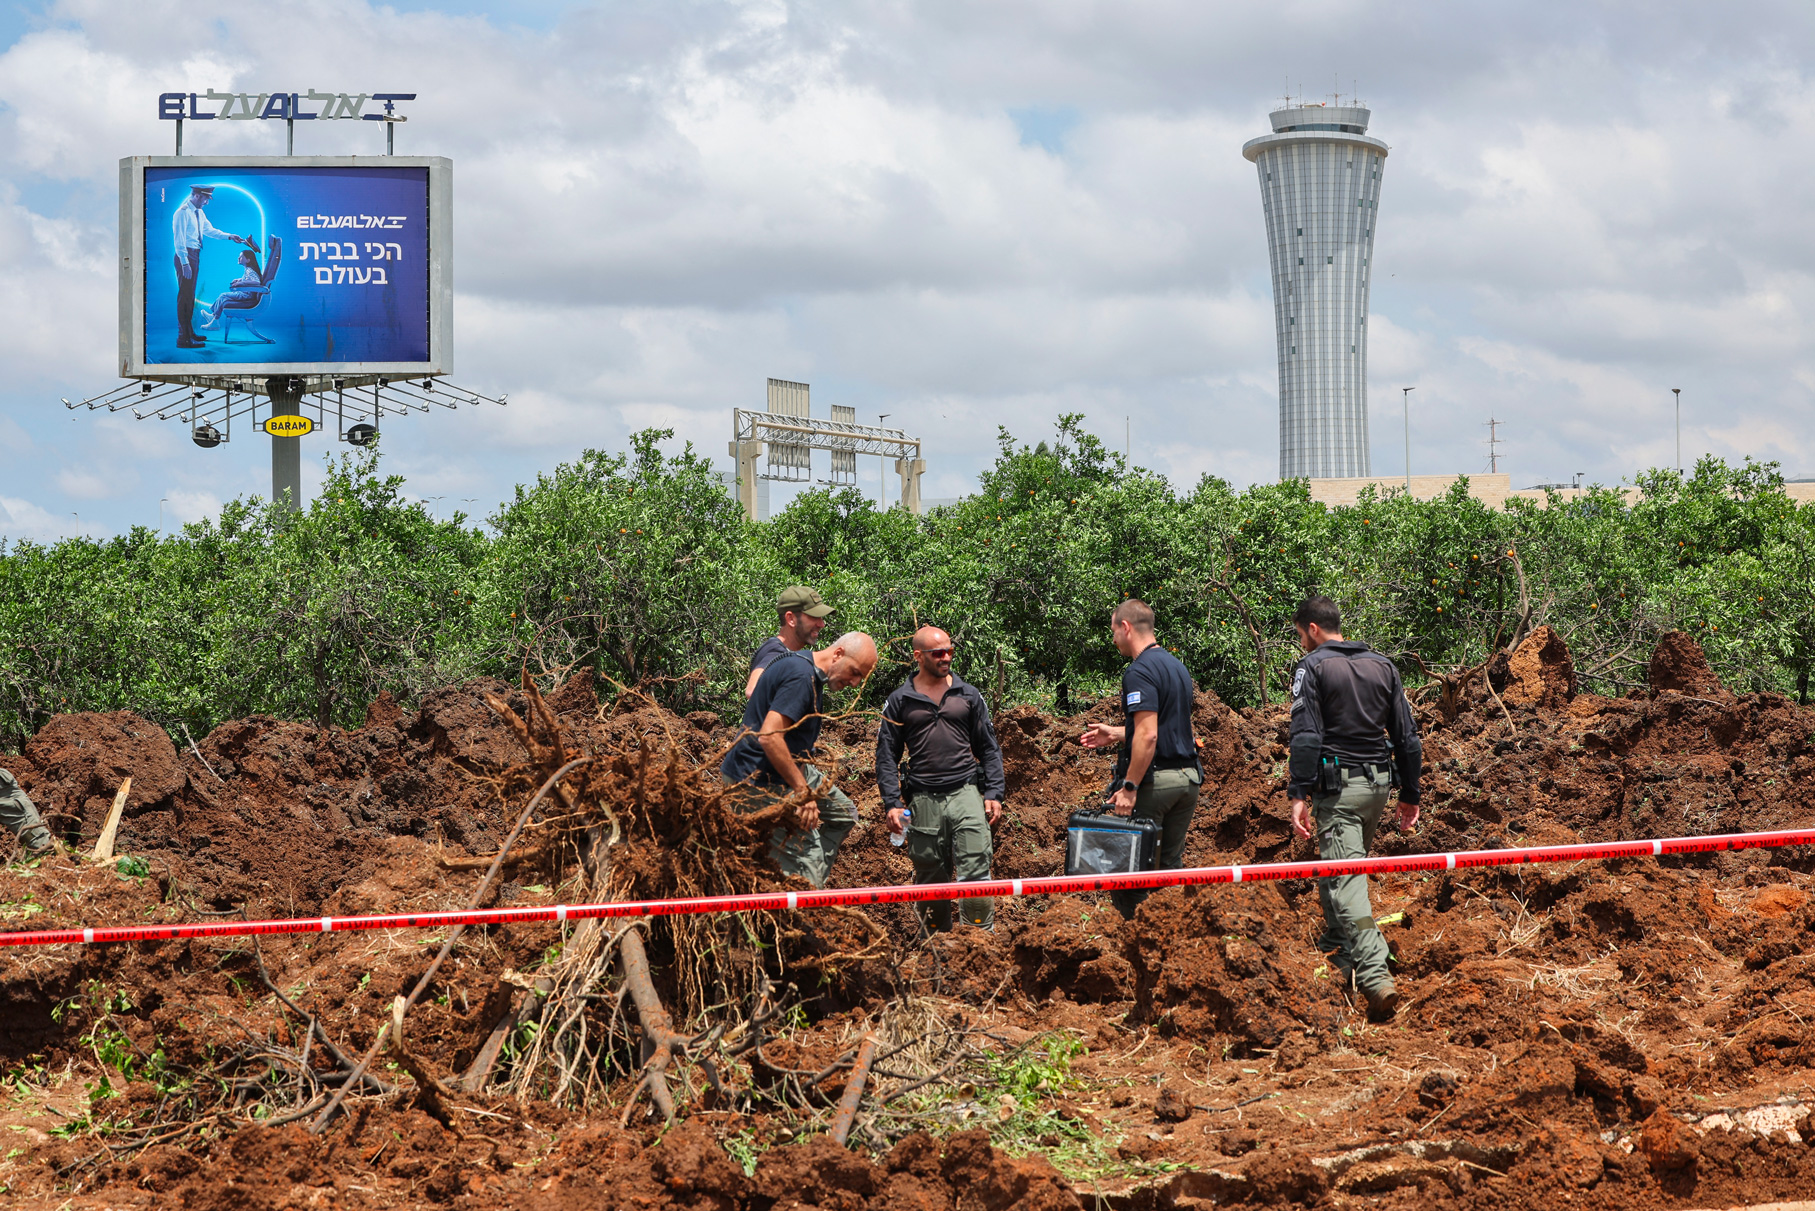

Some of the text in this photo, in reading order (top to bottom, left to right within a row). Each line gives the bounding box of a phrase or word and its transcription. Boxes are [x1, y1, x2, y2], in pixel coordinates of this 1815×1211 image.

[299, 242, 402, 261] הכי בבית
[313, 264, 389, 285] בעולם
[270, 421, 307, 431] BARAM
